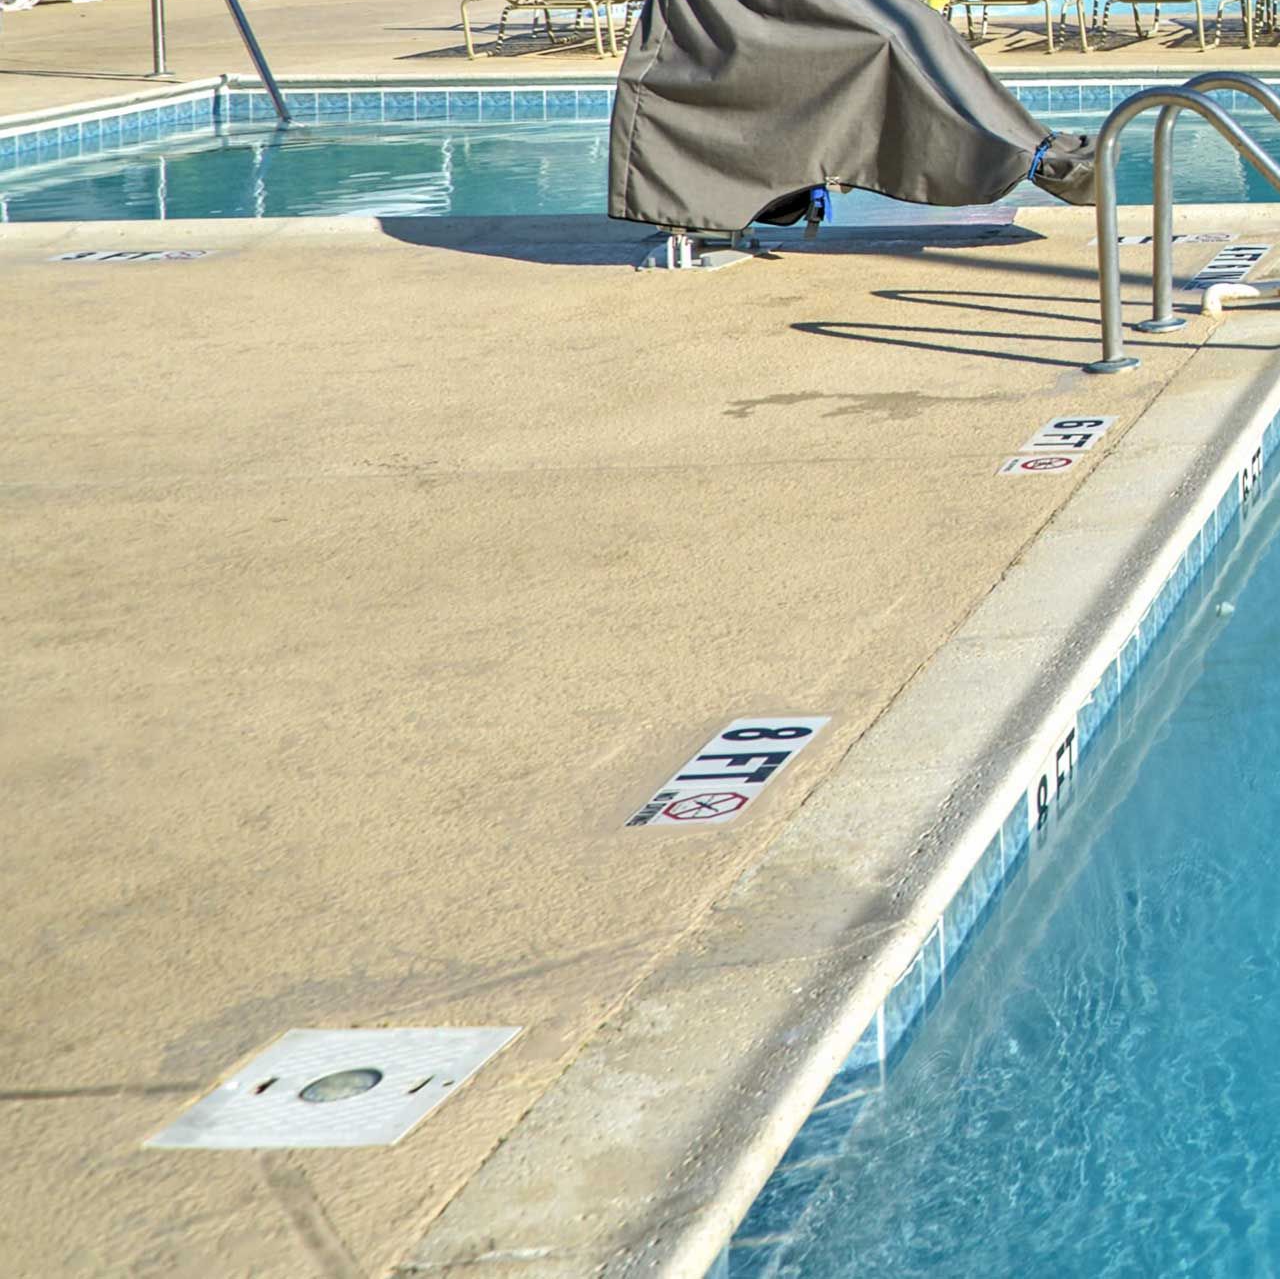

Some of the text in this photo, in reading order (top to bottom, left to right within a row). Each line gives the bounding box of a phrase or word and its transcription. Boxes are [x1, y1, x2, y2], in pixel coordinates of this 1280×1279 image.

[1032, 420, 1104, 448] 6 FT
[1252, 446, 1261, 486] FT
[675, 726, 812, 784] 8 FT
[1037, 727, 1075, 830] 8 FT
